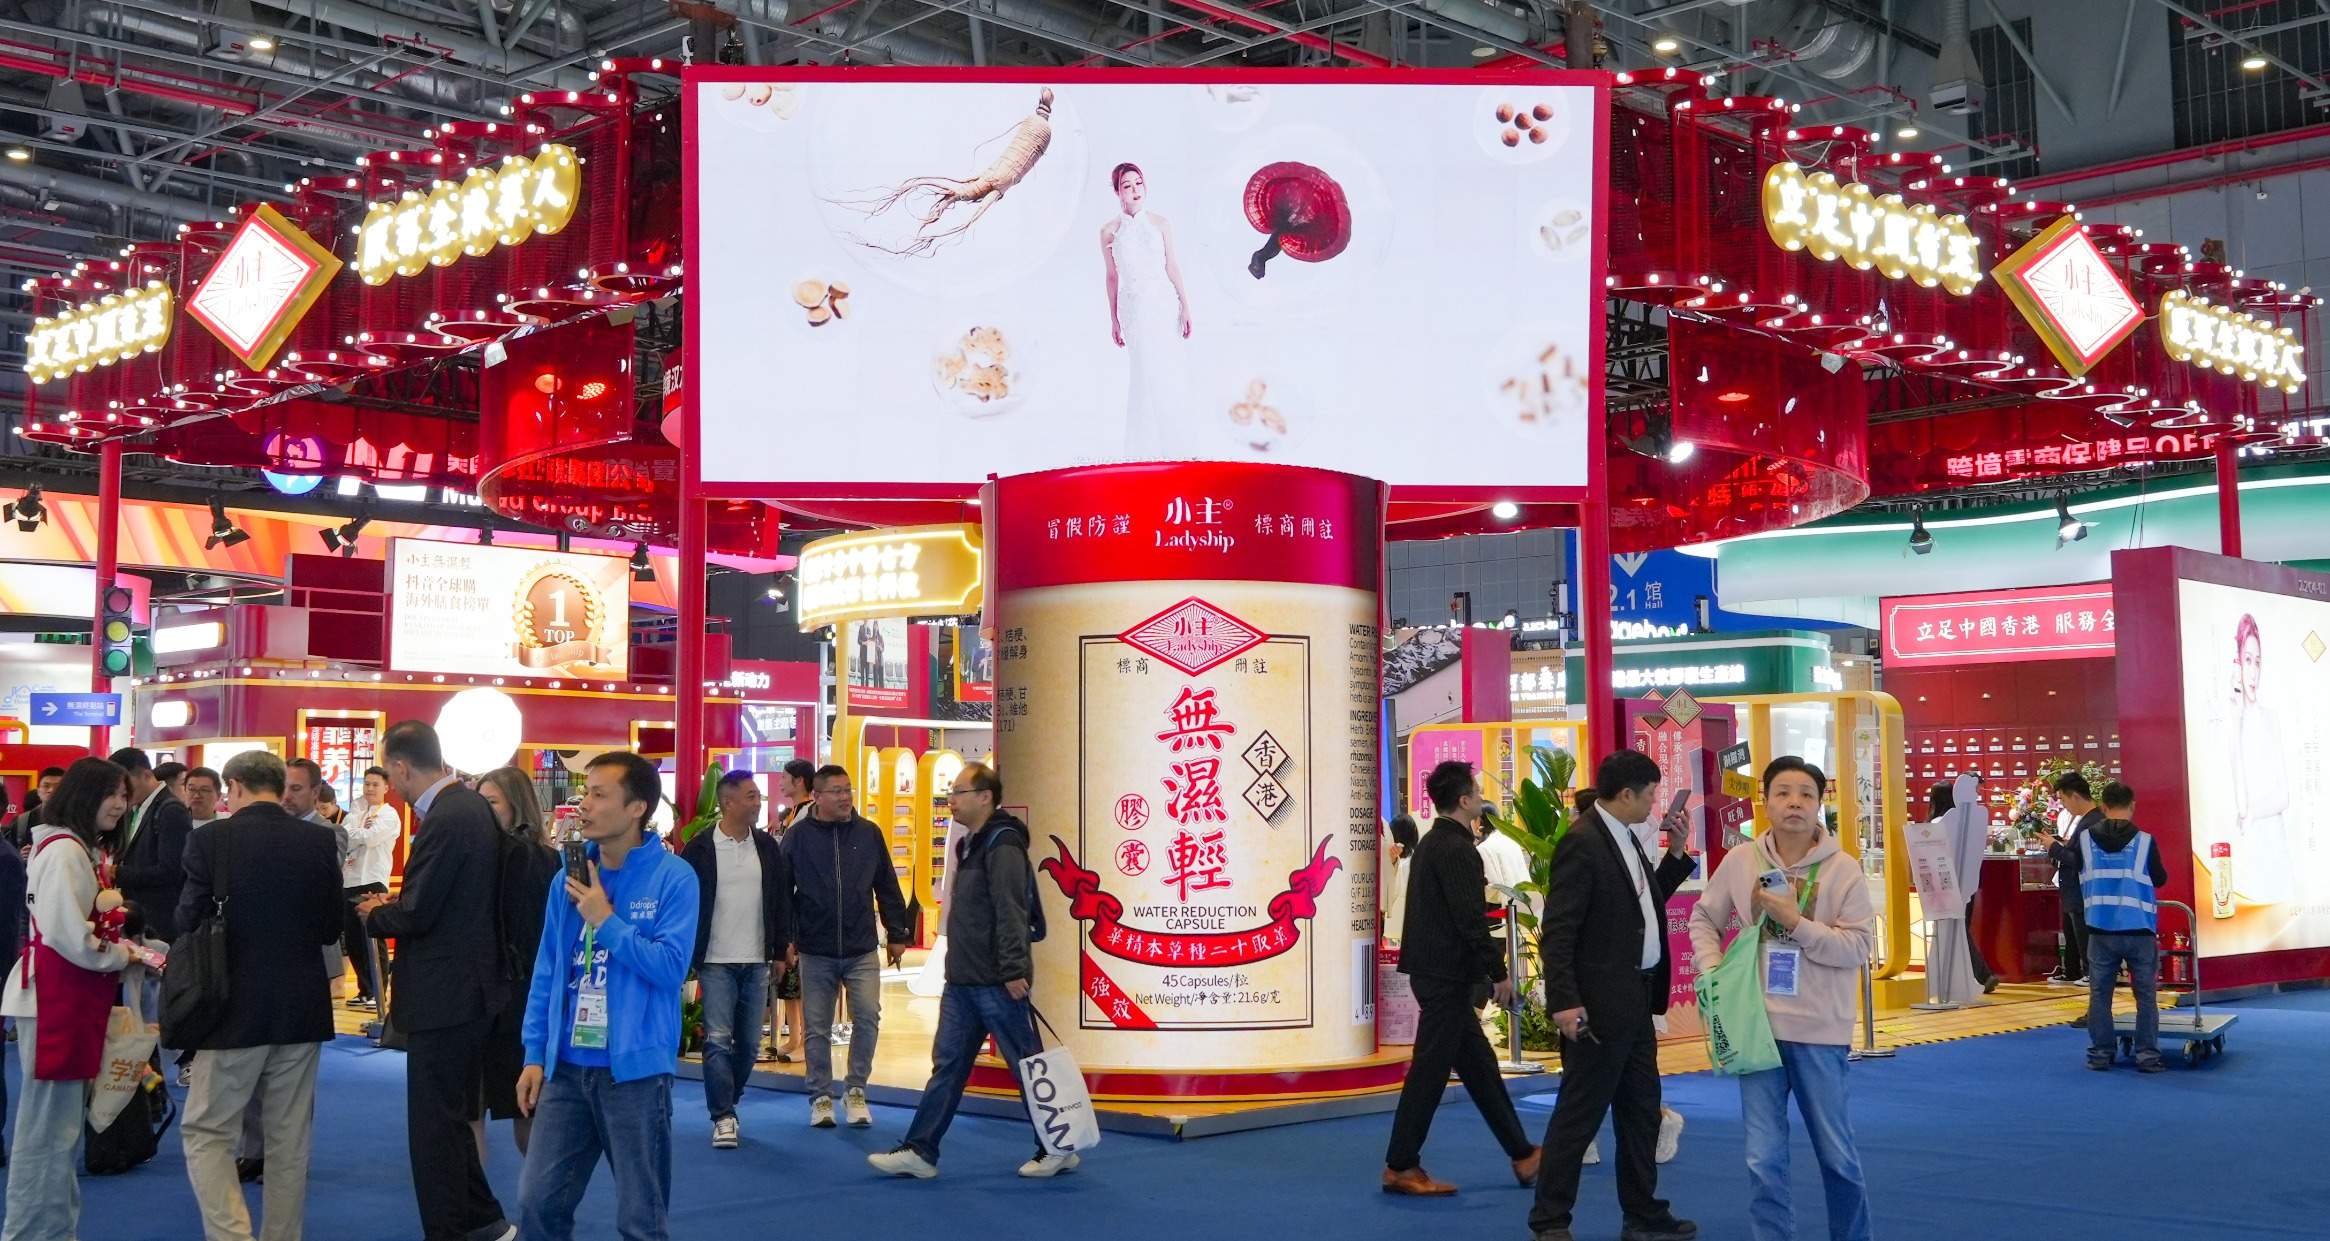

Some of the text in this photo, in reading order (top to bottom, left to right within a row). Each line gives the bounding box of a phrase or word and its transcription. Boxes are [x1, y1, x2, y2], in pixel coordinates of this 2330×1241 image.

[1155, 529, 1235, 553] Ladyship
[548, 589, 571, 627] 1
[1645, 601, 1663, 609] Hall
[544, 628, 575, 644] TOP
[1133, 905, 1257, 918] WATER REDUCTION
[1166, 917, 1225, 930] CAPSULE
[1135, 993, 1152, 1004] Net
